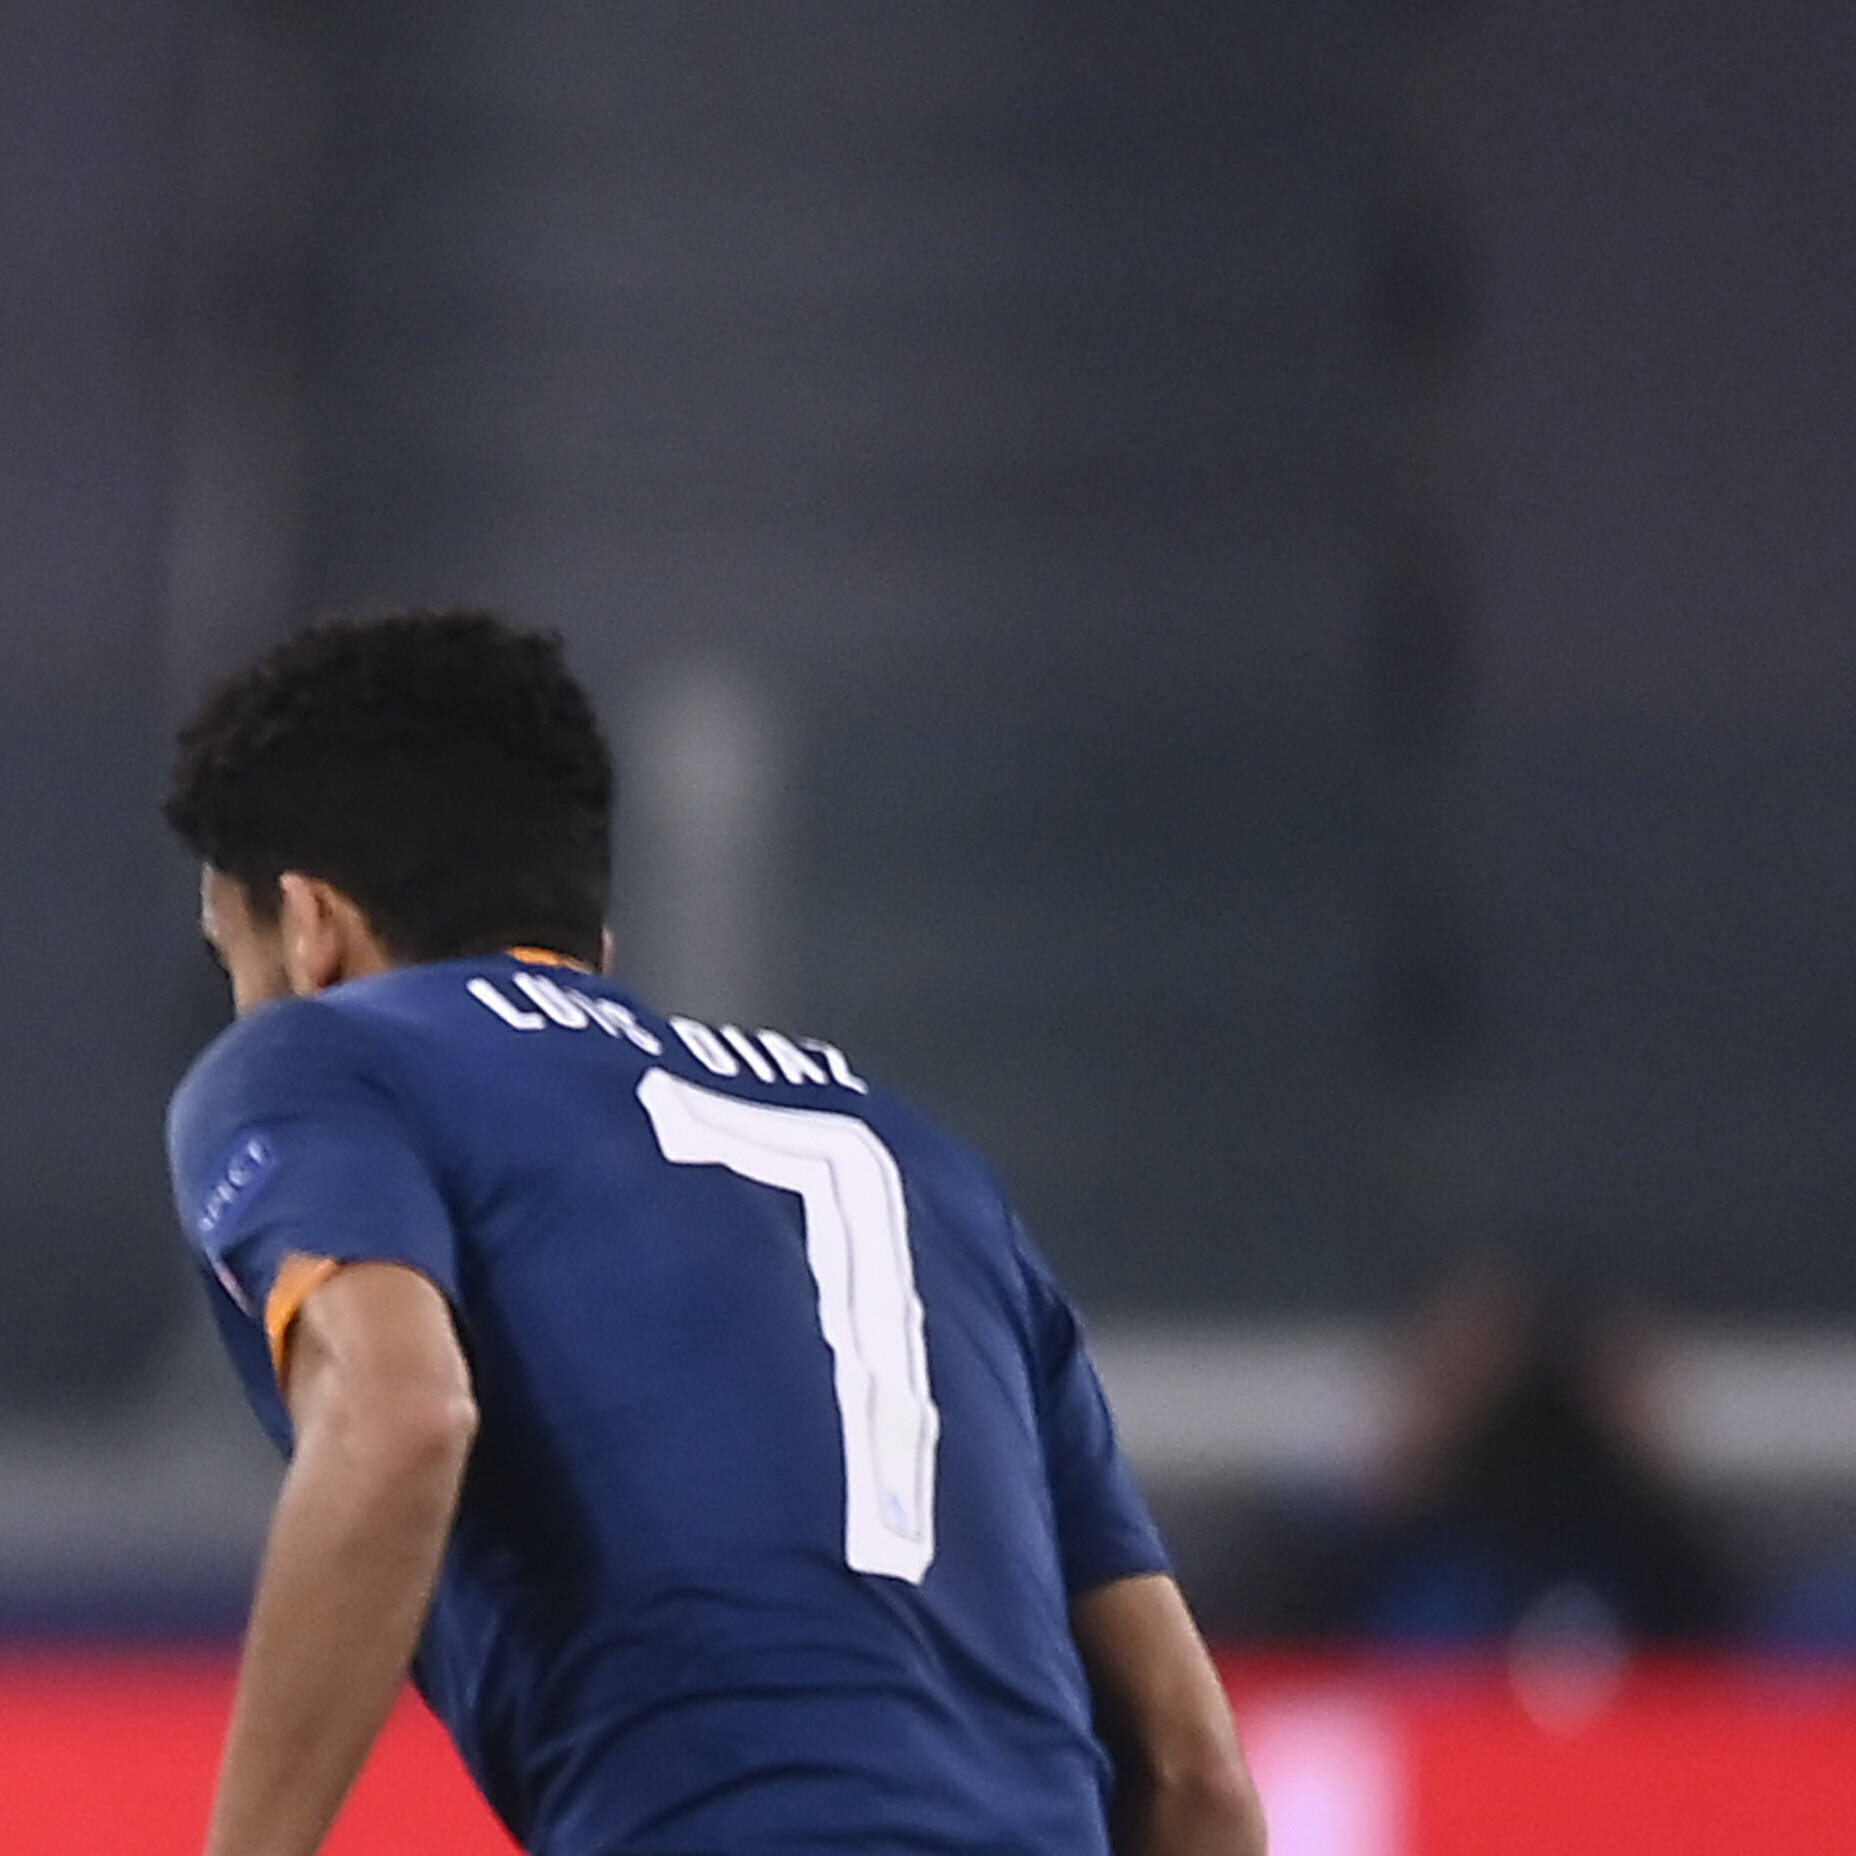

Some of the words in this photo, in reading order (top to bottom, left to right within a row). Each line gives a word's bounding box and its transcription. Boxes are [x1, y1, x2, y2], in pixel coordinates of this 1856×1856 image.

[466, 971, 664, 1056] LUIS
[667, 1014, 869, 1096] DIAZ
[636, 1067, 939, 1585] 7
